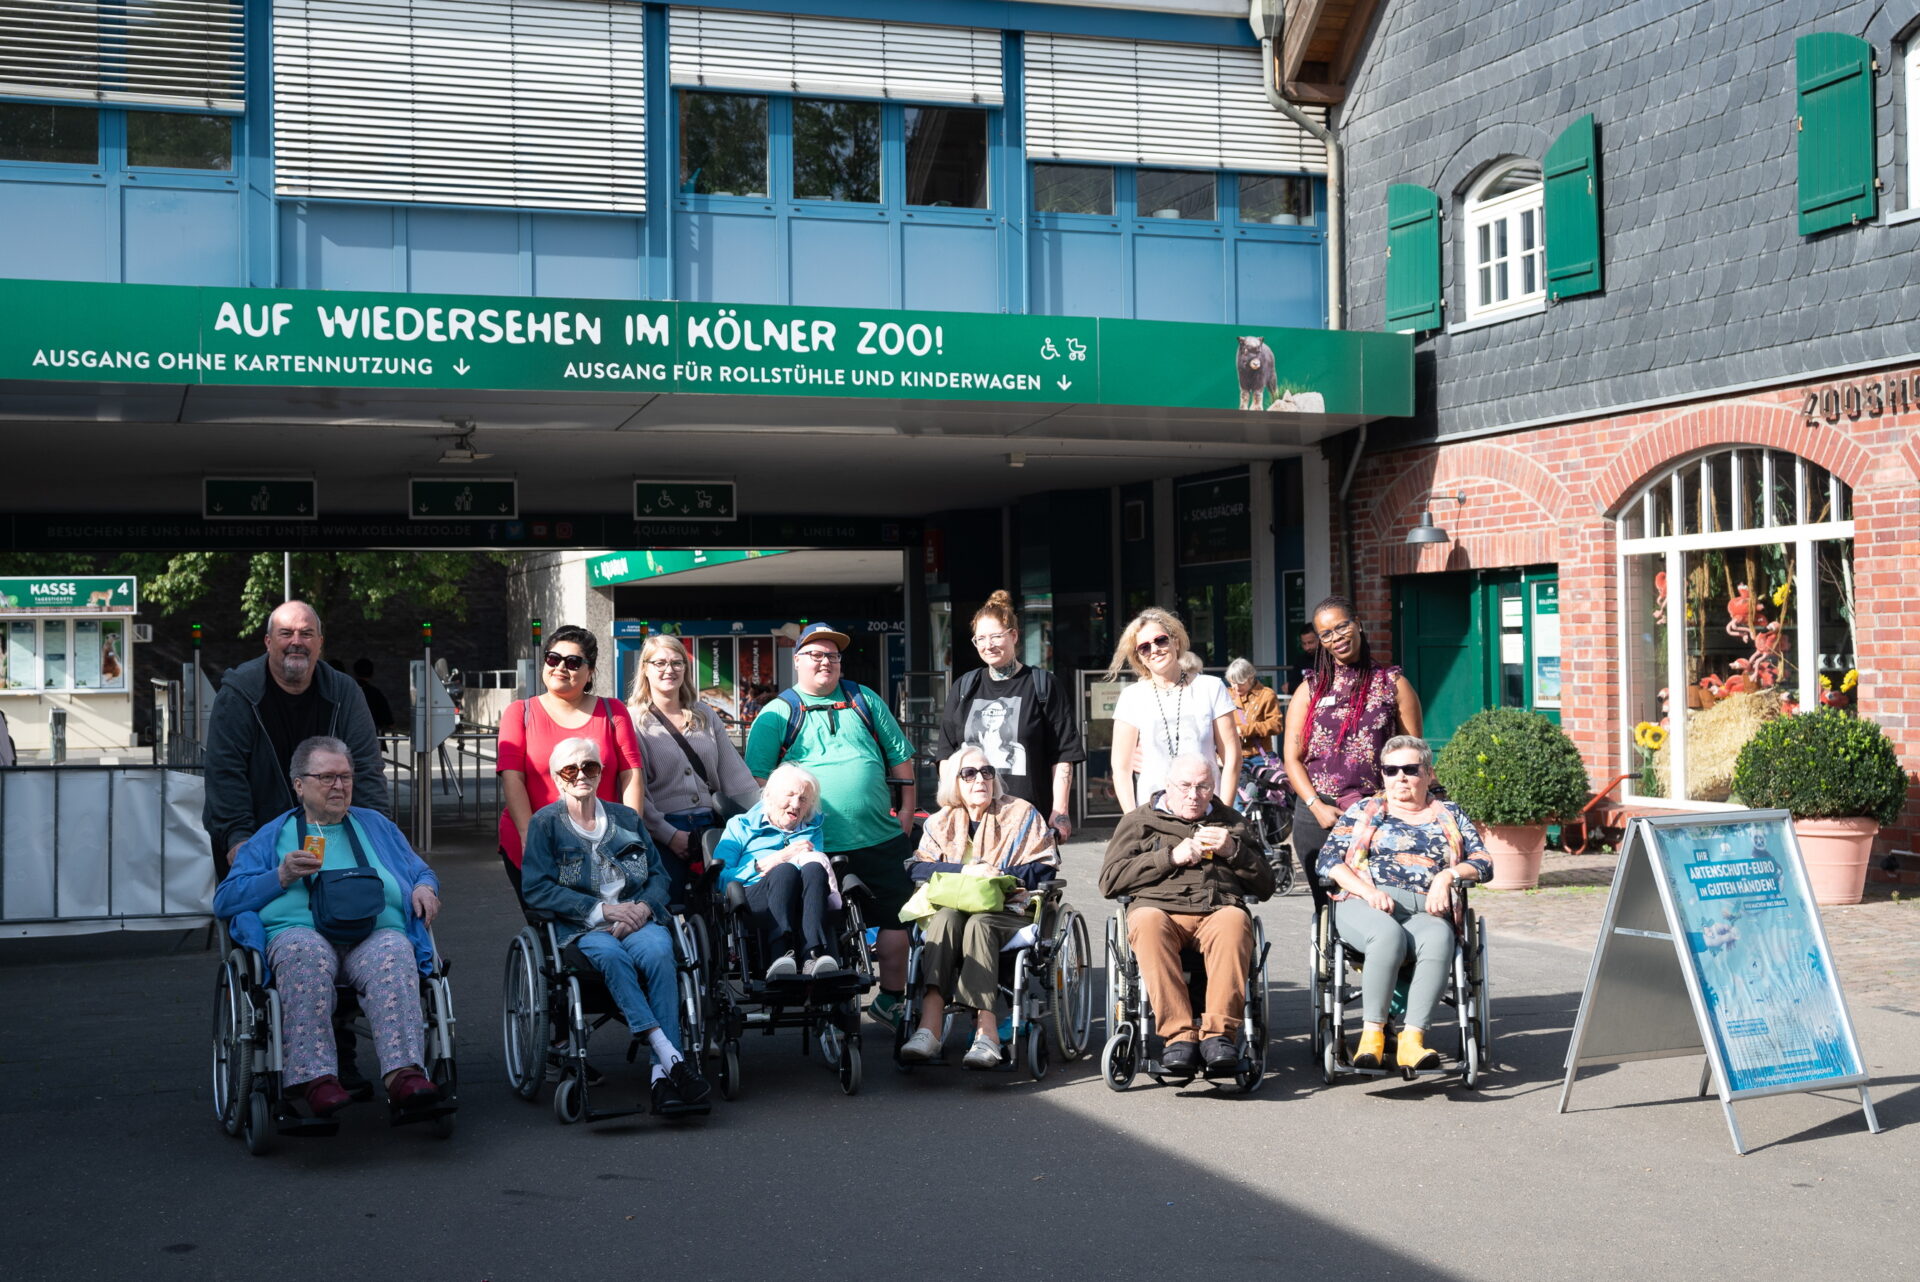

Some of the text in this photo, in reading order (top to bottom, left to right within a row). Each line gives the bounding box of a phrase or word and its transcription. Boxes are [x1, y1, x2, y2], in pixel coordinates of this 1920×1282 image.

[214, 302, 943, 357] AUF WIEDERSEHEN IM KÖLNER ZOO!
[32, 349, 433, 375] AUSGANG OHNE KARTENNUTZUNG
[563, 360, 1041, 390] AUSGANG FÜR ROLLSTÜHLE UND KINDERWAGEN
[47, 525, 472, 537] BESUCHEN SIE UNS IM INTERNET UNTER WWW.KOELNERZOO.DE
[633, 526, 700, 537] AQUARIUM
[803, 527, 856, 537] LINIE 140
[30, 582, 77, 596] KASSE
[117, 582, 129, 597] 4
[1690, 861, 1774, 880] ARTENSCHUTZ-EURO
[1699, 877, 1777, 897] IN GUTEN HÄNDEN!
